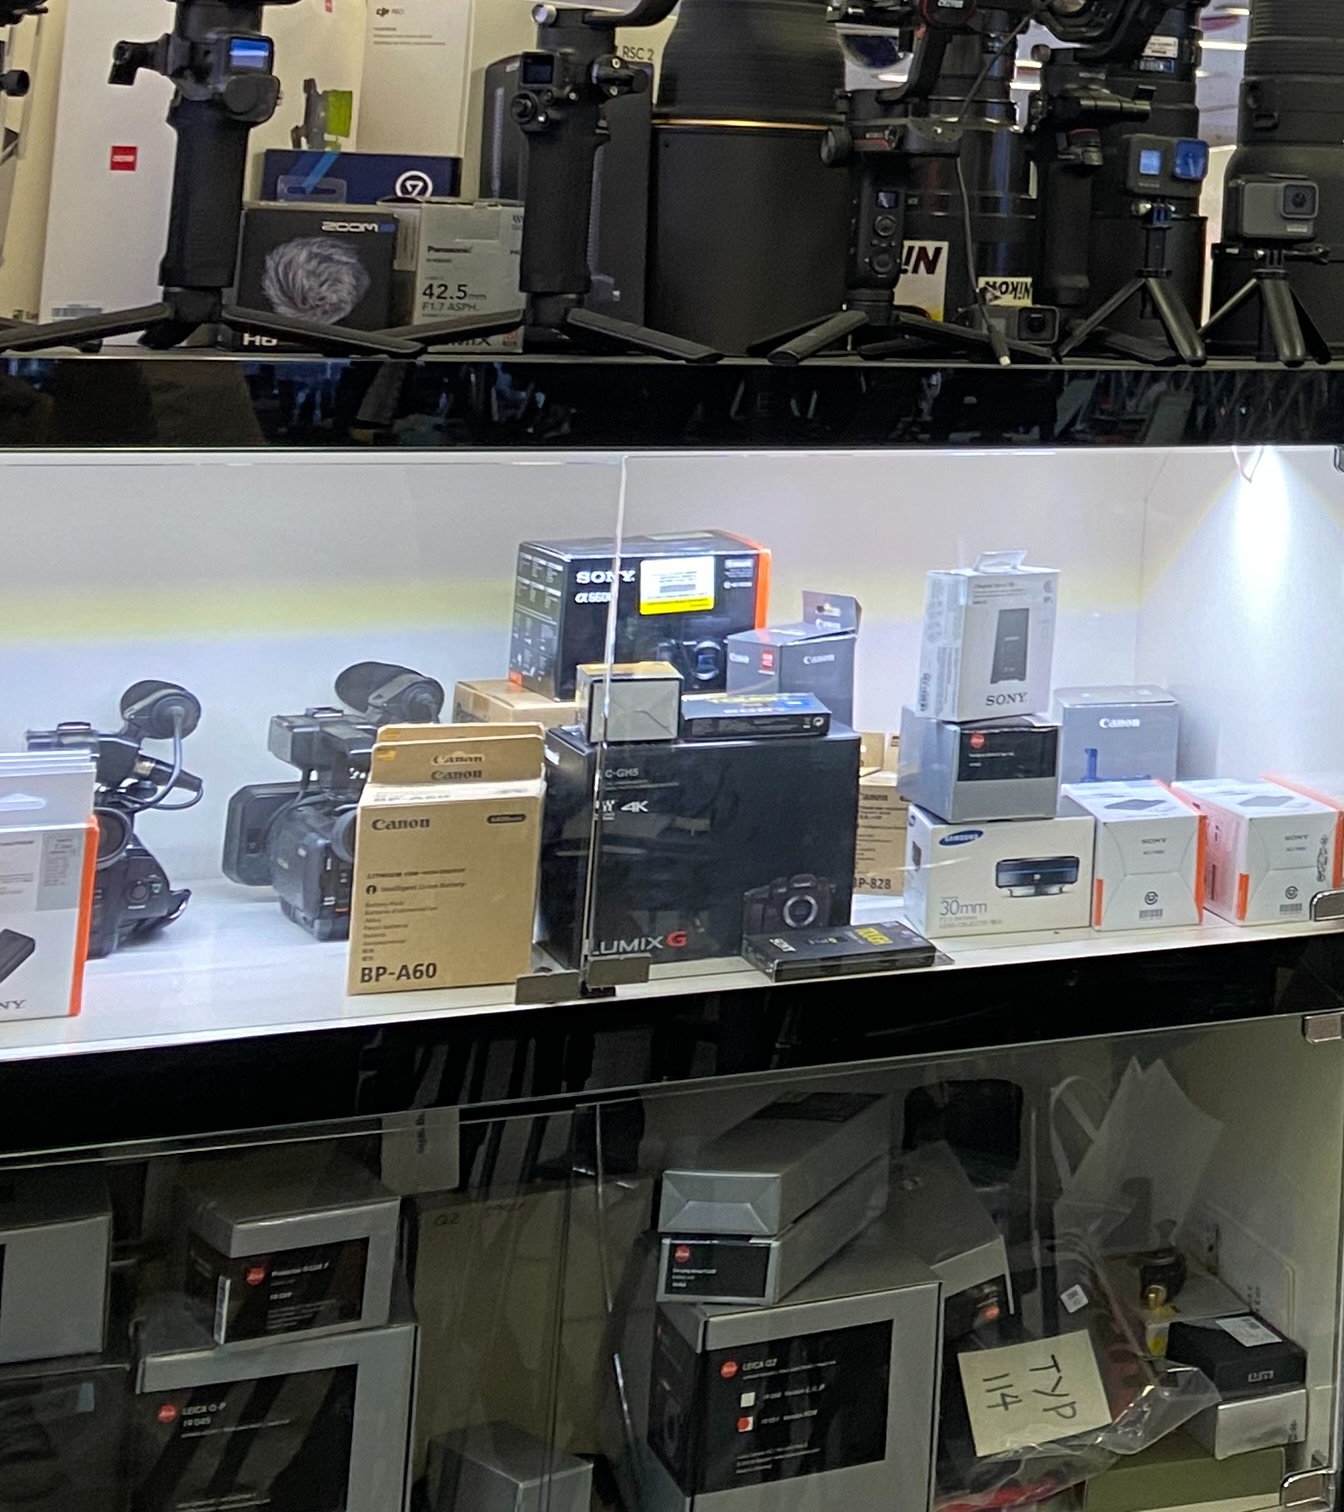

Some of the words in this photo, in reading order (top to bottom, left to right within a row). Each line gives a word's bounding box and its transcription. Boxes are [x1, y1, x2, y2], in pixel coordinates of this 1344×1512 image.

[622, 45, 646, 60] RSC
[575, 570, 636, 585] SONY
[984, 692, 1028, 707] SONY
[1099, 717, 1141, 729] Canon
[430, 769, 483, 781] Canon
[604, 767, 639, 779] C-GH5
[371, 818, 431, 831] Canon
[939, 899, 988, 916] 30mm
[592, 935, 664, 955] UMIX
[666, 930, 688, 947] G
[360, 962, 437, 984] BP-A60
